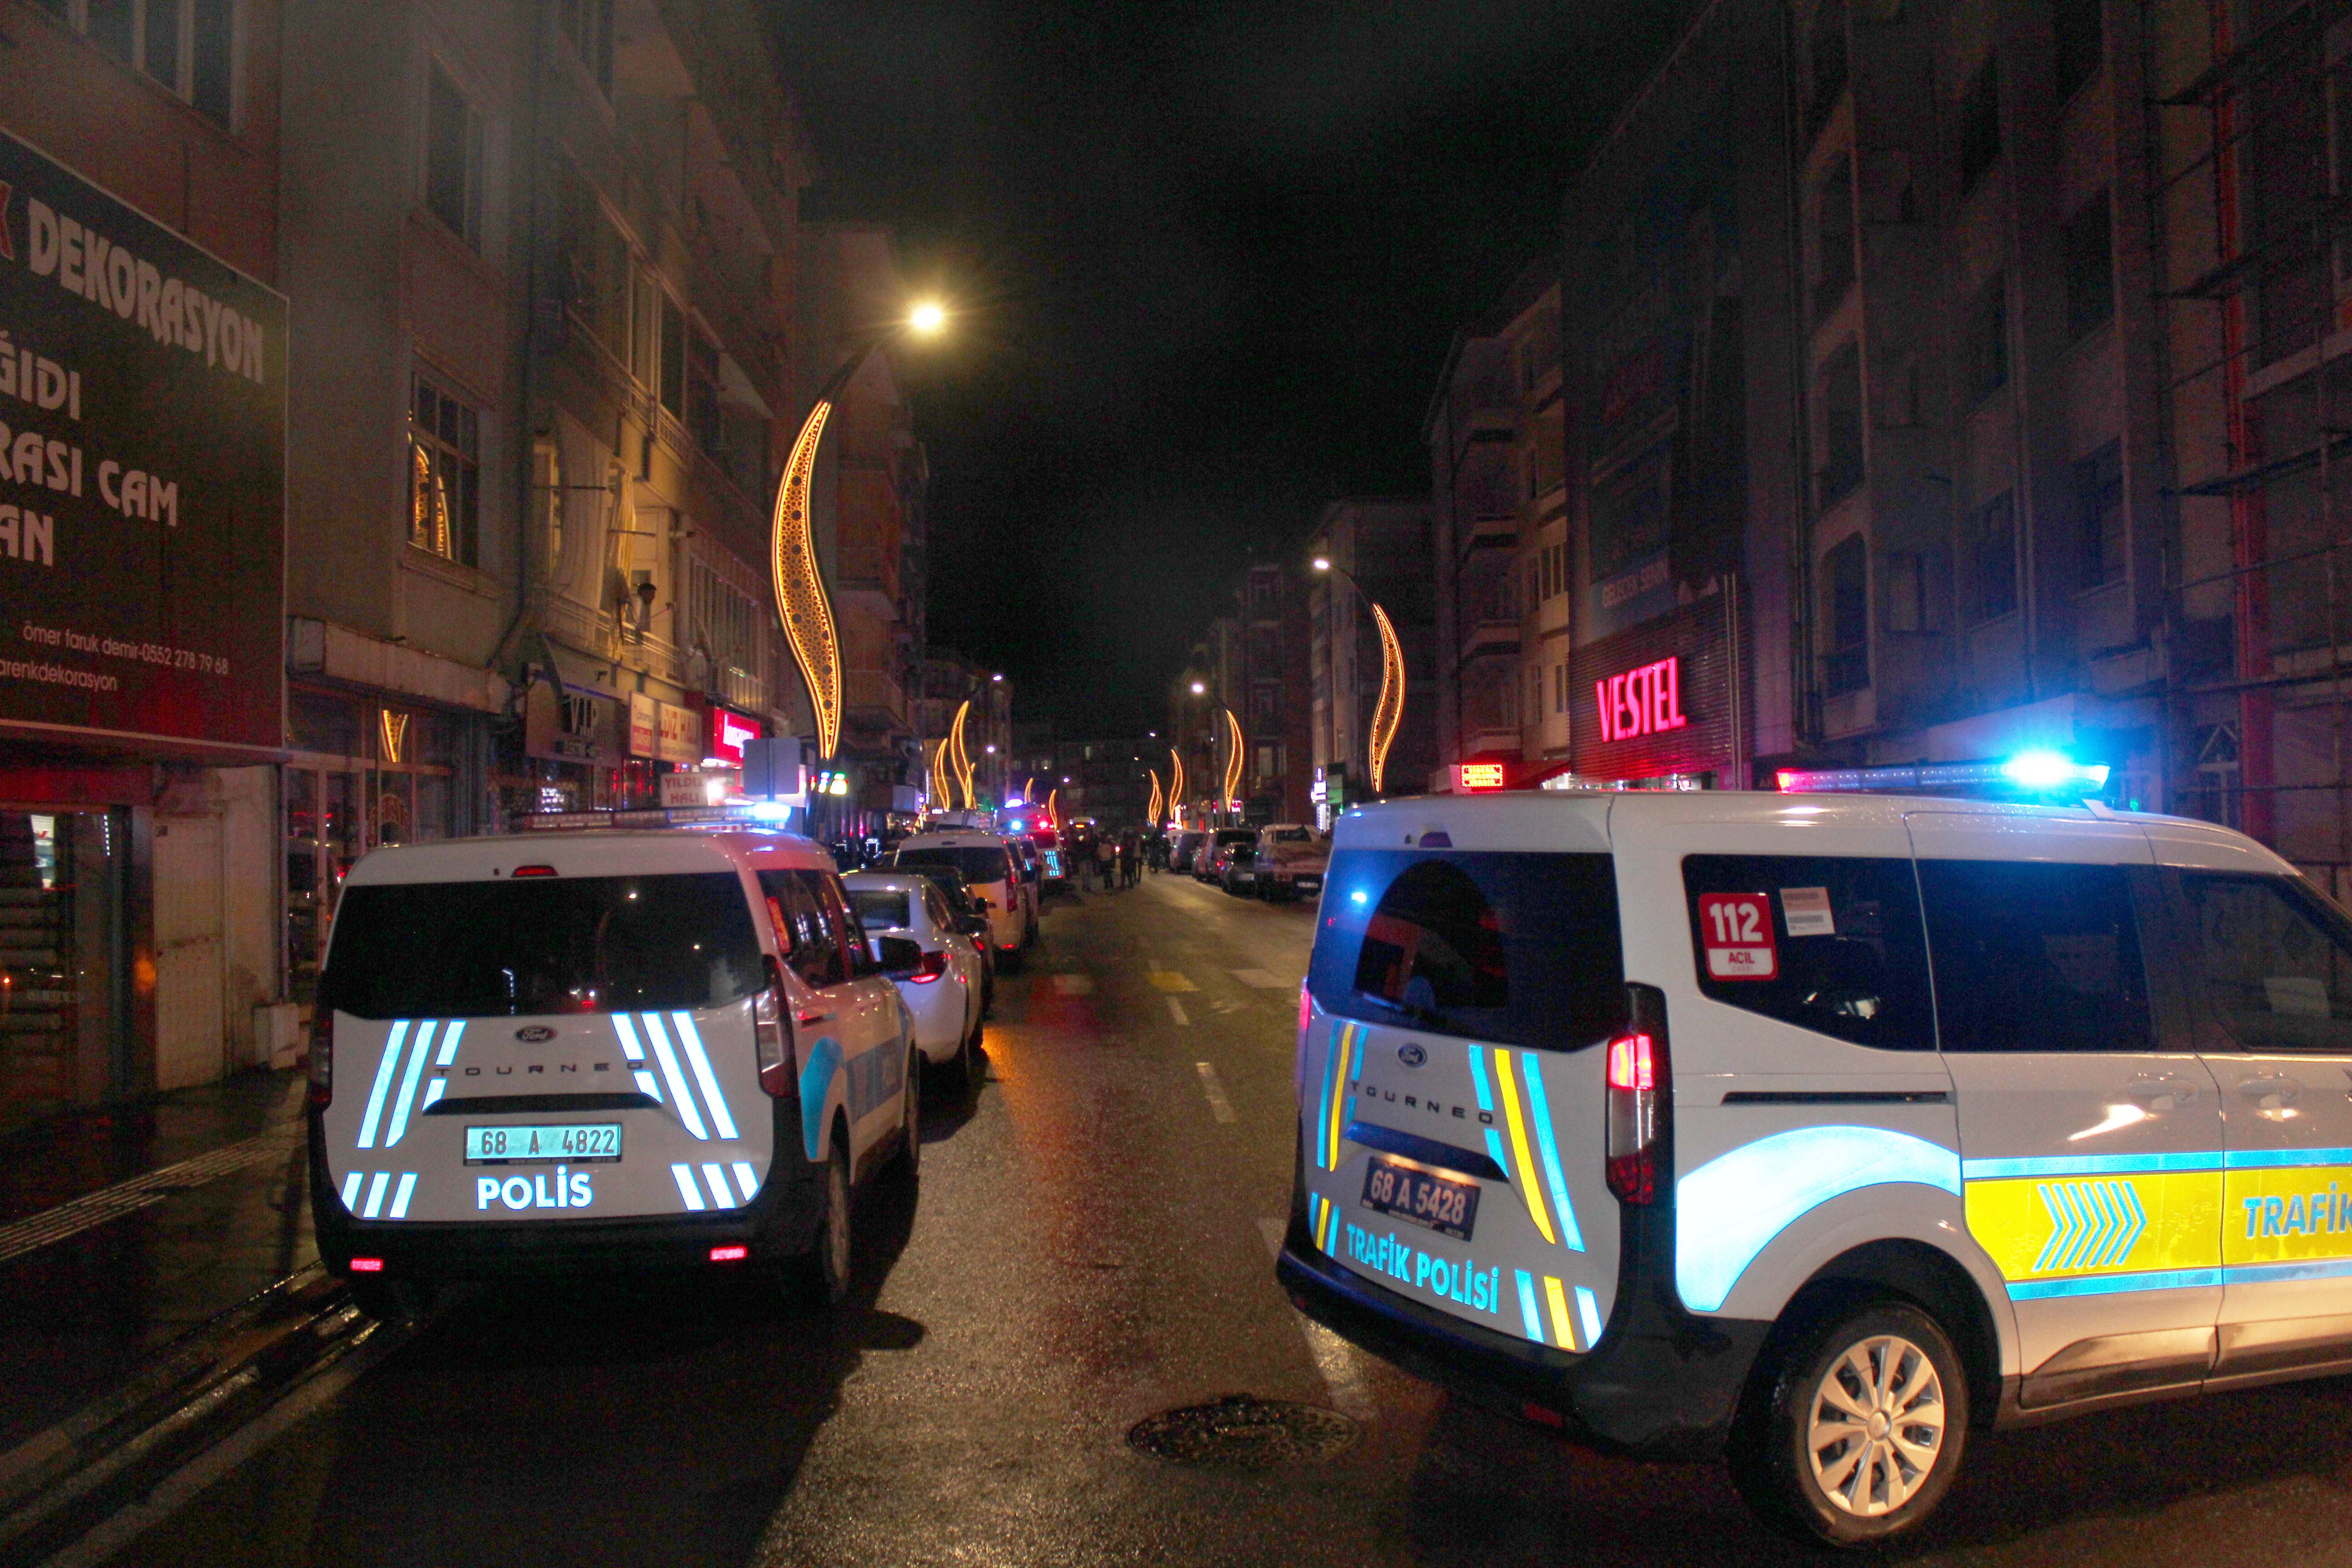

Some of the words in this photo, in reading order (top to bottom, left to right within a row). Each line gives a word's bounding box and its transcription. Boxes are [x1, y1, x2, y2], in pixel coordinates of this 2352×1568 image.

[28, 197, 263, 384] DEKORASYON
[98, 460, 177, 526] CAM
[23, 620, 61, 646] ömer
[65, 628, 99, 652] faruk
[174, 649, 196, 670] 278
[199, 654, 212, 671] 79
[215, 657, 228, 675] 68
[1595, 656, 1687, 743] VESTEL
[1709, 902, 1764, 942] 112
[435, 1061, 643, 1076] TOURNEO
[1351, 1080, 1494, 1125] TOURNEO
[481, 1131, 507, 1155] 68
[528, 1130, 539, 1155] A
[562, 1130, 615, 1154] 4822
[477, 1163, 593, 1210] POLİS
[1371, 1170, 1395, 1203] 68
[1396, 1178, 1411, 1210] A
[1416, 1182, 1466, 1225] 5428
[1347, 1224, 1410, 1283] TRAFİK
[1416, 1251, 1499, 1314] POLİSİ
